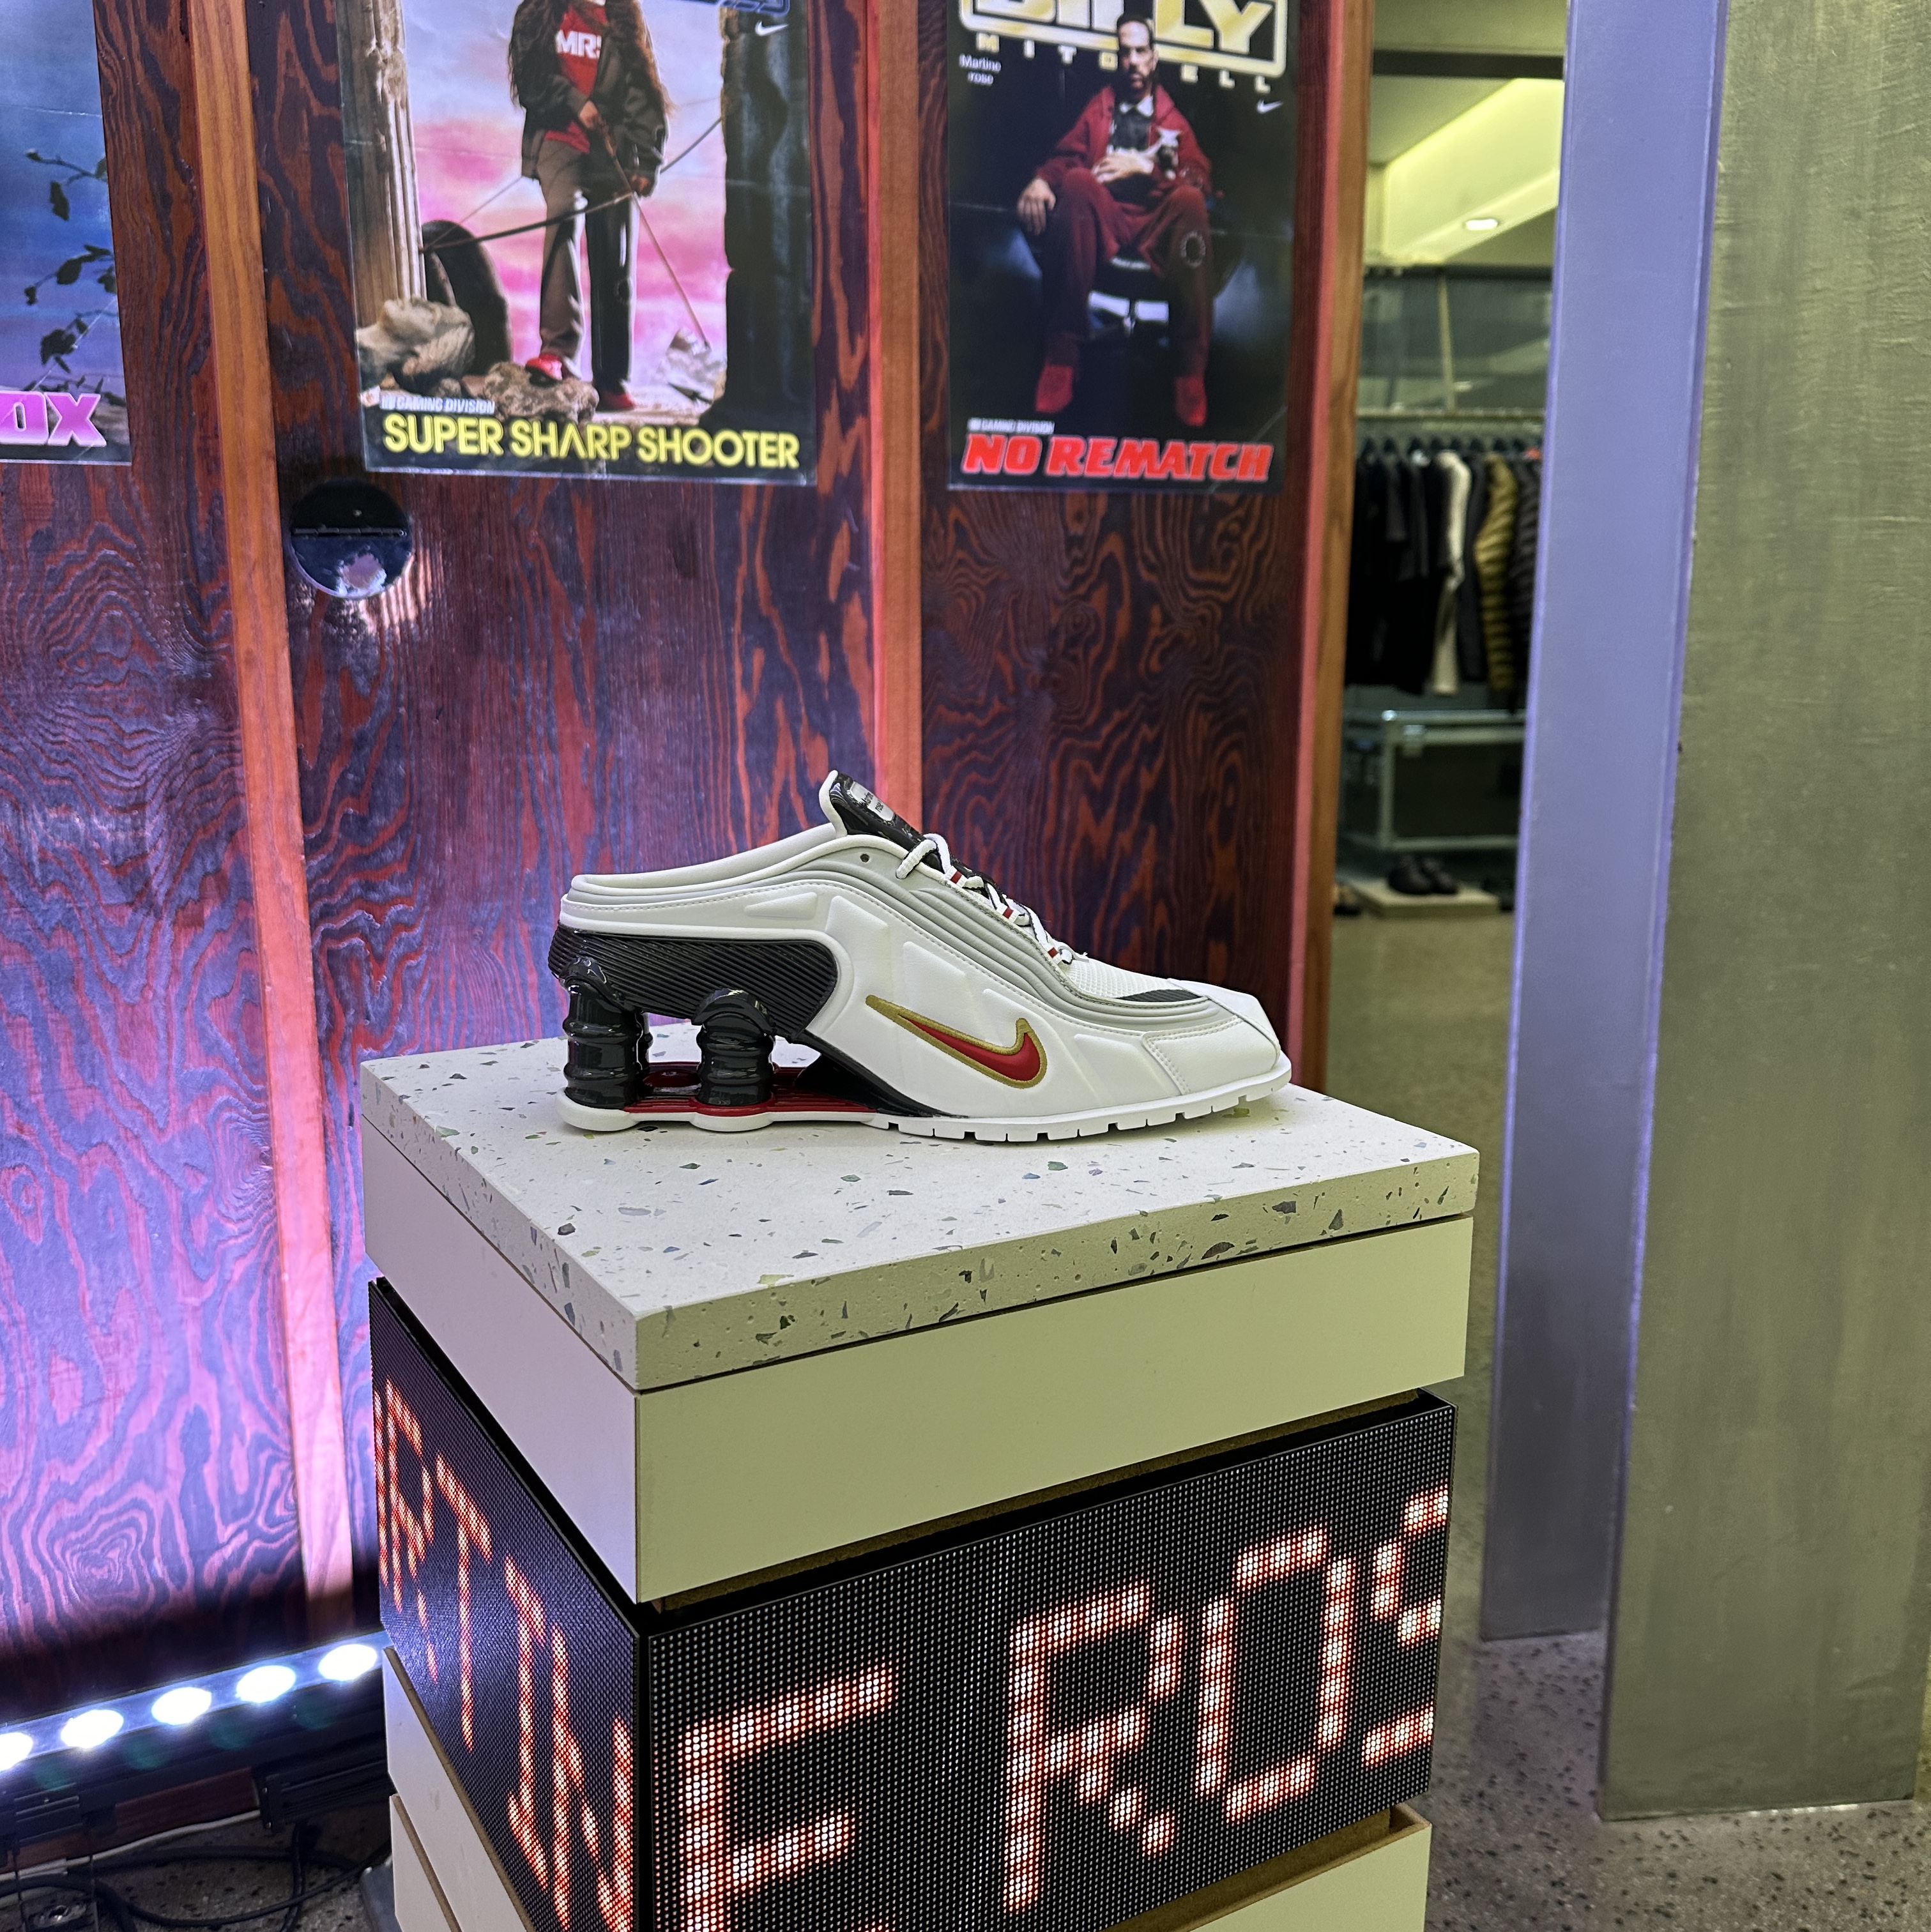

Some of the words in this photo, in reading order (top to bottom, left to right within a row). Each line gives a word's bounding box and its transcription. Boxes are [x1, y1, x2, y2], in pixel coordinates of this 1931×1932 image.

[395, 395, 443, 412] GAMING
[445, 397, 496, 414] DIVISION
[383, 413, 505, 457] SUPER
[510, 419, 632, 460] SHARP
[636, 427, 800, 469] SHOOTER
[961, 433, 1042, 475] NO
[1044, 434, 1275, 482] REMATCH
